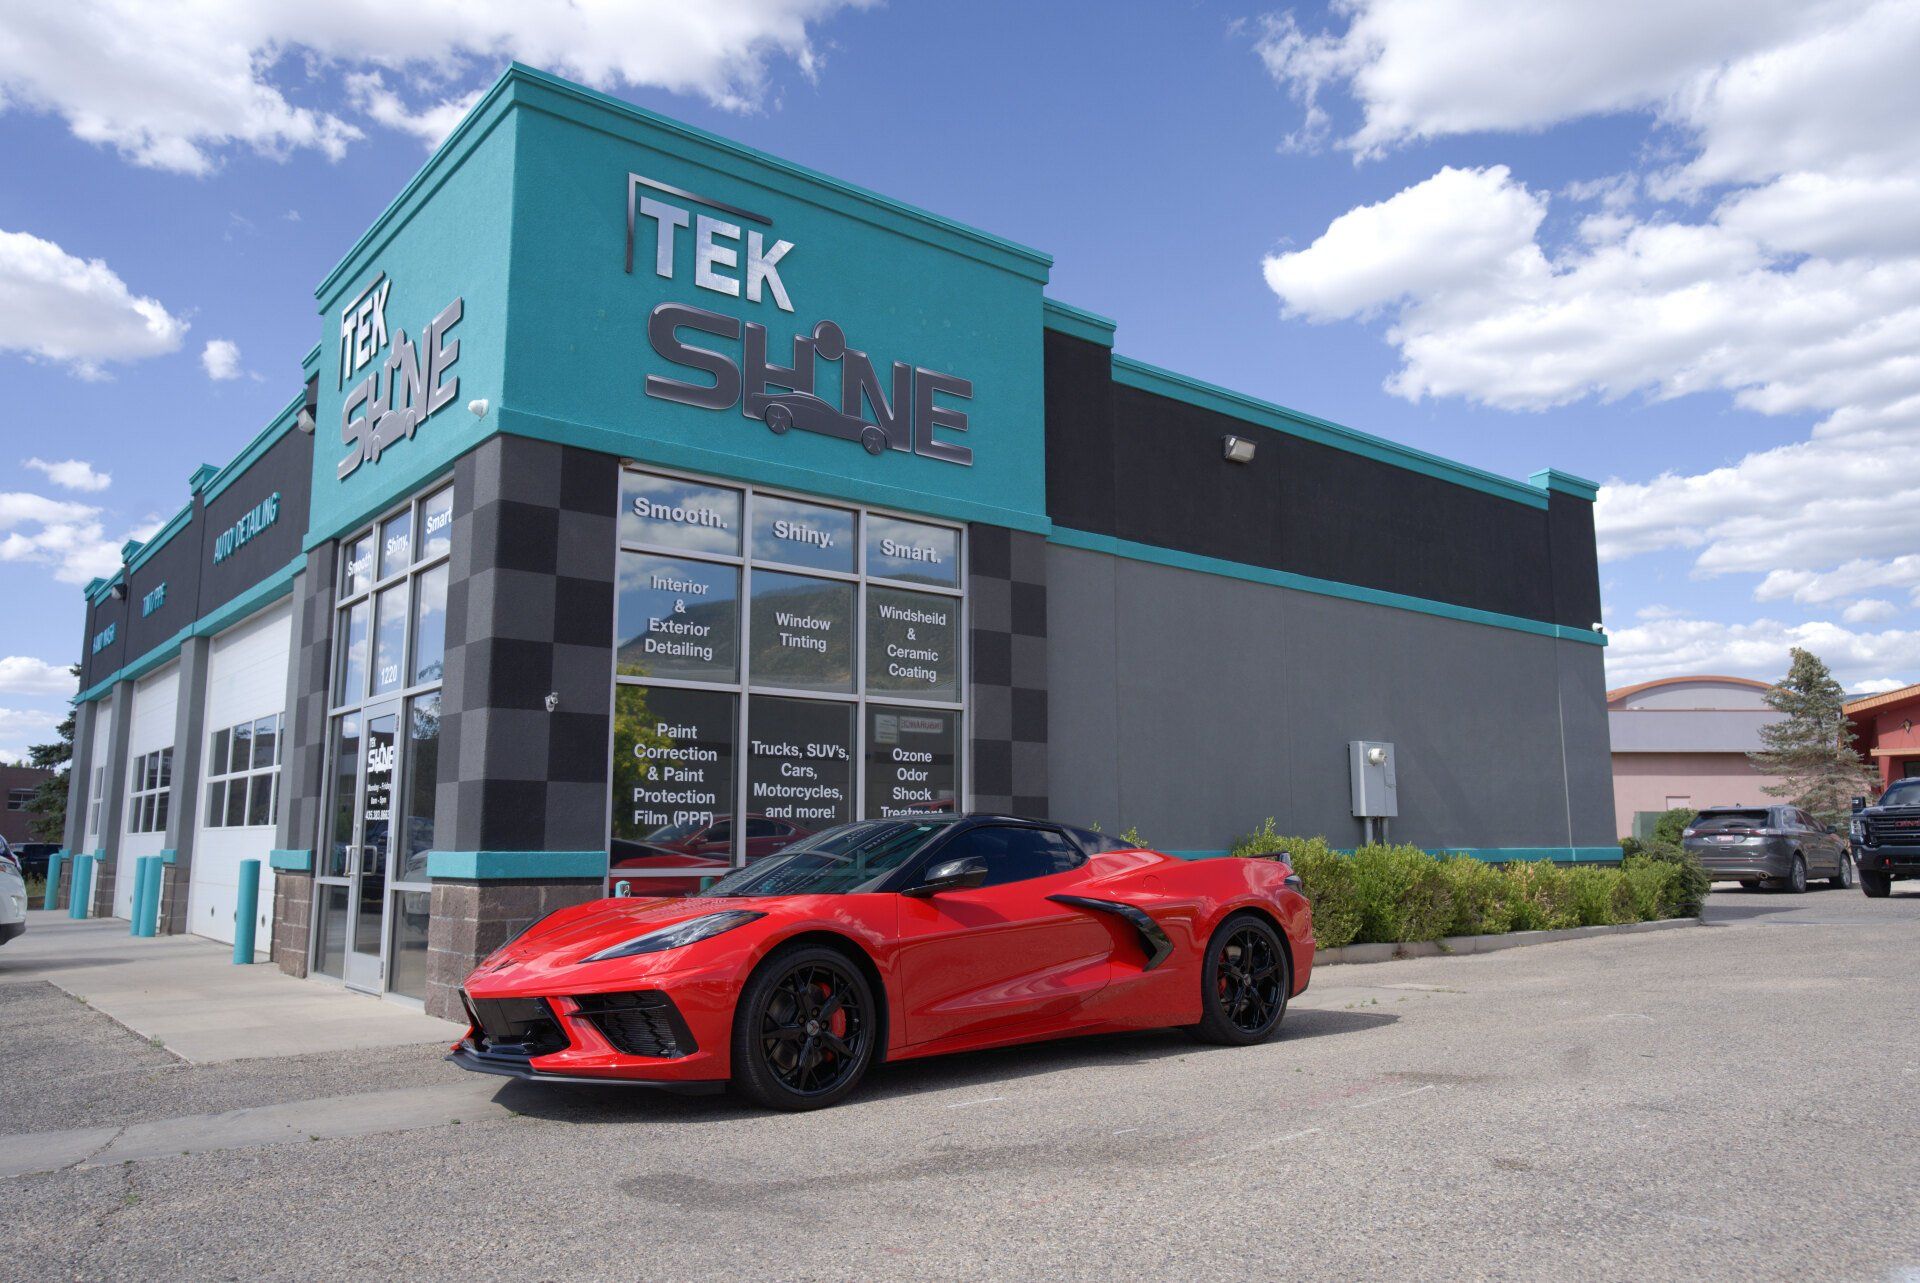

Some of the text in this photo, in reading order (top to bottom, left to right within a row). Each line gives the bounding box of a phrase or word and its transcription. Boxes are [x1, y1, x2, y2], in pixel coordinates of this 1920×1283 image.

[640, 196, 795, 313] TEK
[343, 279, 391, 379] TEK
[337, 297, 462, 480] SHINE
[646, 302, 973, 466] SHINE
[633, 497, 728, 530] Smooth.
[213, 492, 279, 566] AUTO DETAILING
[773, 520, 834, 549] Shiny.
[386, 534, 408, 556] Shiny.
[881, 539, 942, 564] Smart.
[652, 575, 709, 596] Interior
[674, 599, 686, 614] &
[879, 605, 947, 626] Windsheild
[649, 617, 710, 637] Exterior
[775, 612, 831, 631] Window
[780, 633, 827, 653] Tinting
[907, 628, 916, 641] &
[645, 639, 713, 662] Detailing
[887, 644, 939, 662] Ceramic
[381, 664, 398, 686] 1220
[888, 663, 937, 683] Coating
[657, 723, 697, 739] Paint
[634, 744, 717, 762] Correction
[751, 740, 850, 760] Trucks, SUV's,
[892, 748, 932, 762] Ozone
[647, 767, 704, 782] & Paint
[781, 763, 818, 780] Cars,
[897, 768, 928, 782] Odor
[633, 788, 715, 805] Protection
[753, 783, 843, 801] Motorcycles,
[892, 787, 932, 801] Shock
[634, 811, 714, 829] Film (PPF)
[765, 805, 836, 819] and more!
